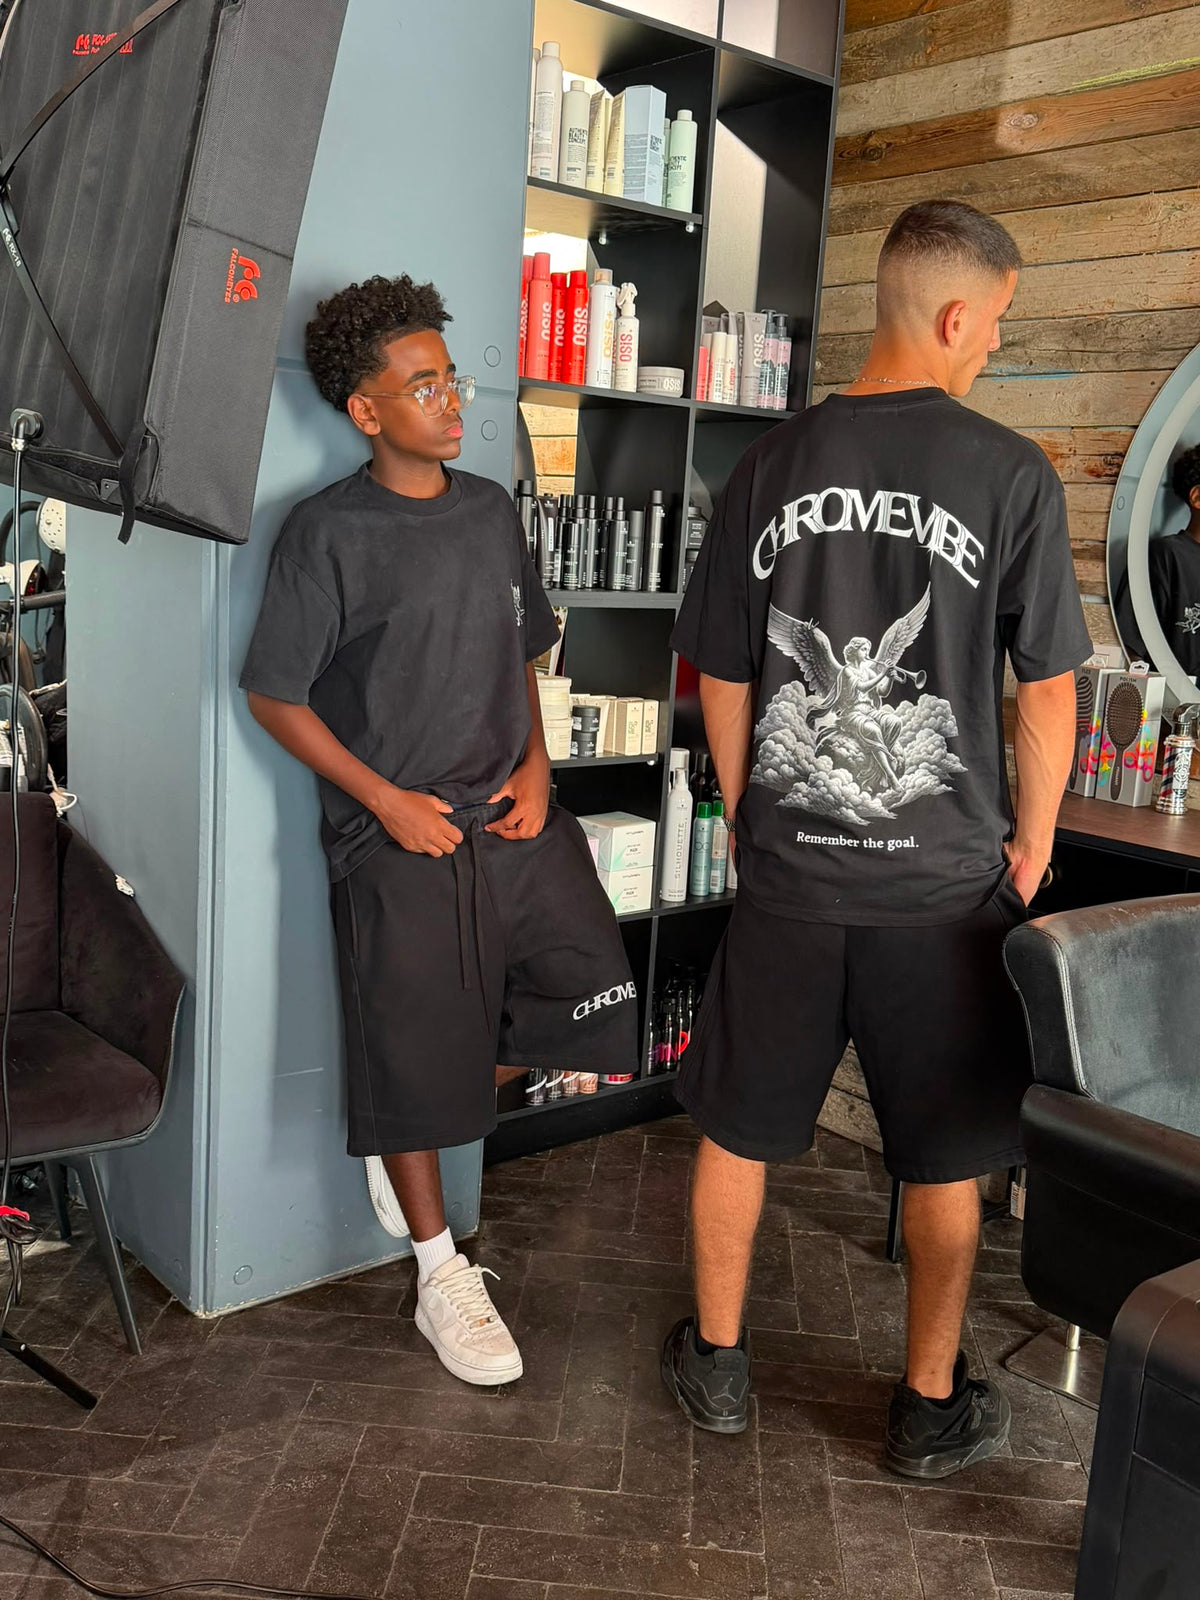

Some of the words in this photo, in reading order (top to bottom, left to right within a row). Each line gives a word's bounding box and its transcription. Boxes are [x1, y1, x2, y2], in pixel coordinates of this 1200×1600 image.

[224, 248, 239, 303] FALCONEYES
[752, 486, 985, 589] CHROMEVIBE
[796, 831, 860, 848] Remember
[863, 837, 884, 848] the
[887, 835, 920, 852] goal.
